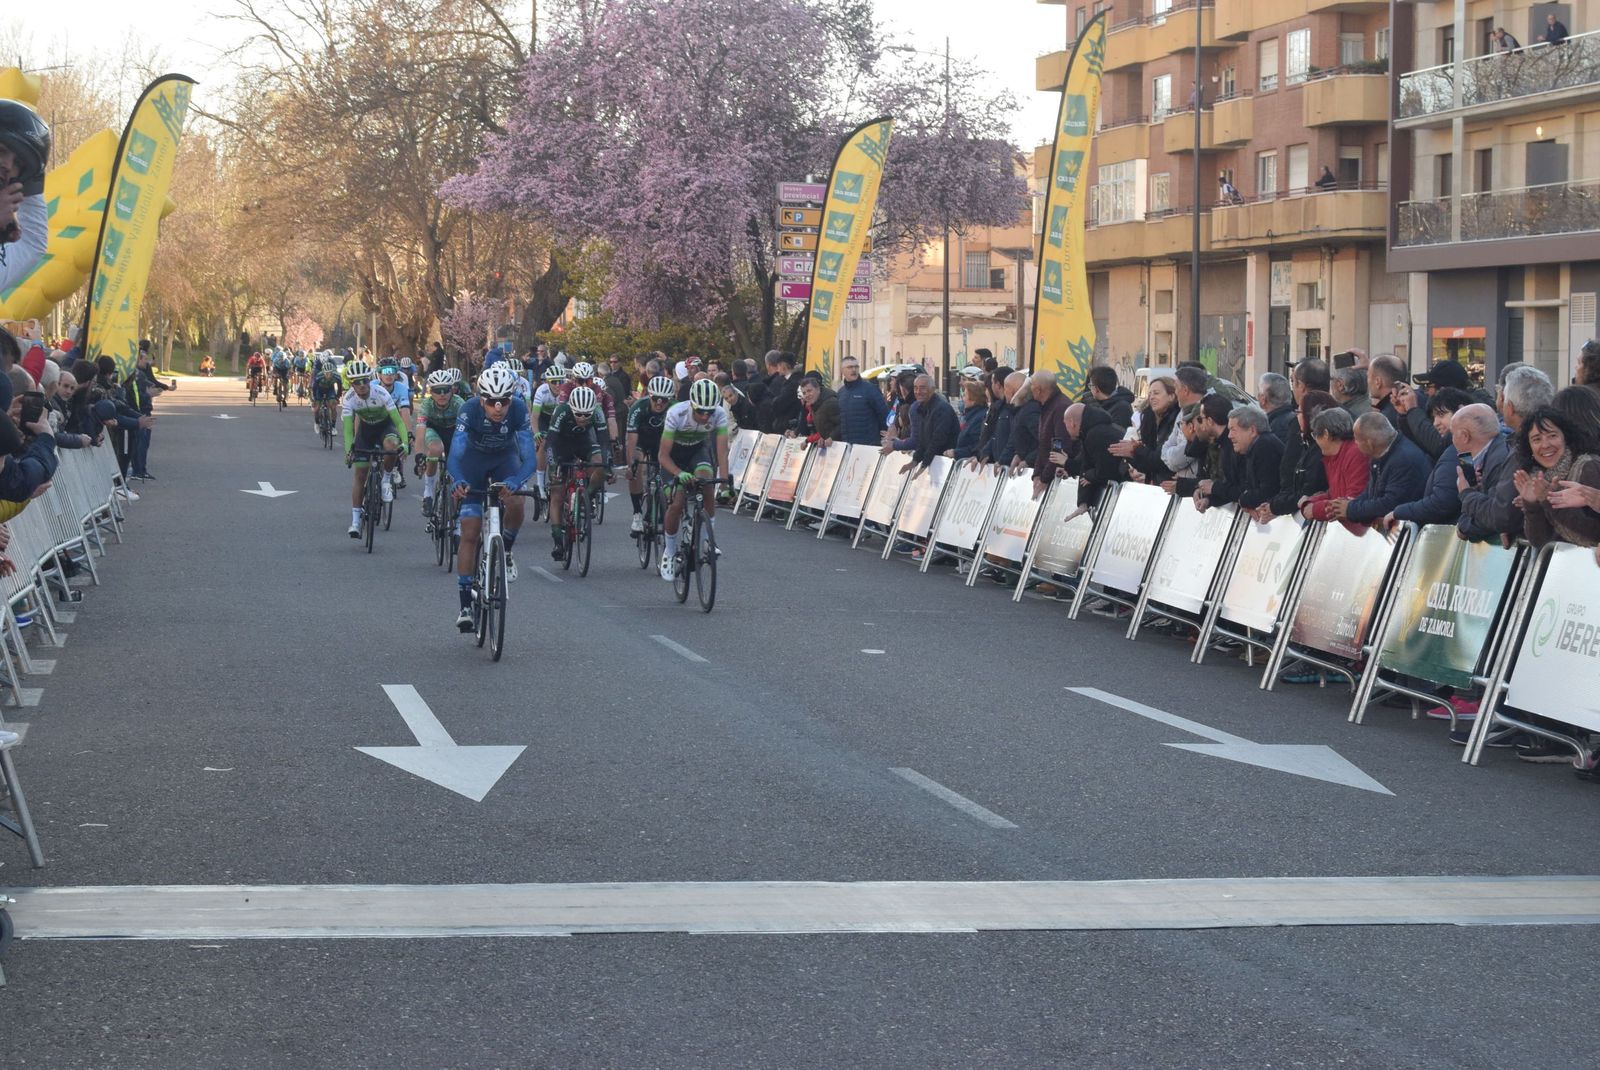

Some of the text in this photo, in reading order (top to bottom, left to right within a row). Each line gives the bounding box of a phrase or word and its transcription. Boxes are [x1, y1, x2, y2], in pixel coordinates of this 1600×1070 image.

[784, 192, 820, 200] provincial
[1426, 582, 1494, 619] CAJA RURAL
[1566, 602, 1587, 617] GRUPO
[1418, 616, 1456, 638] DE ZAMORA
[1555, 618, 1600, 657] IBERE
